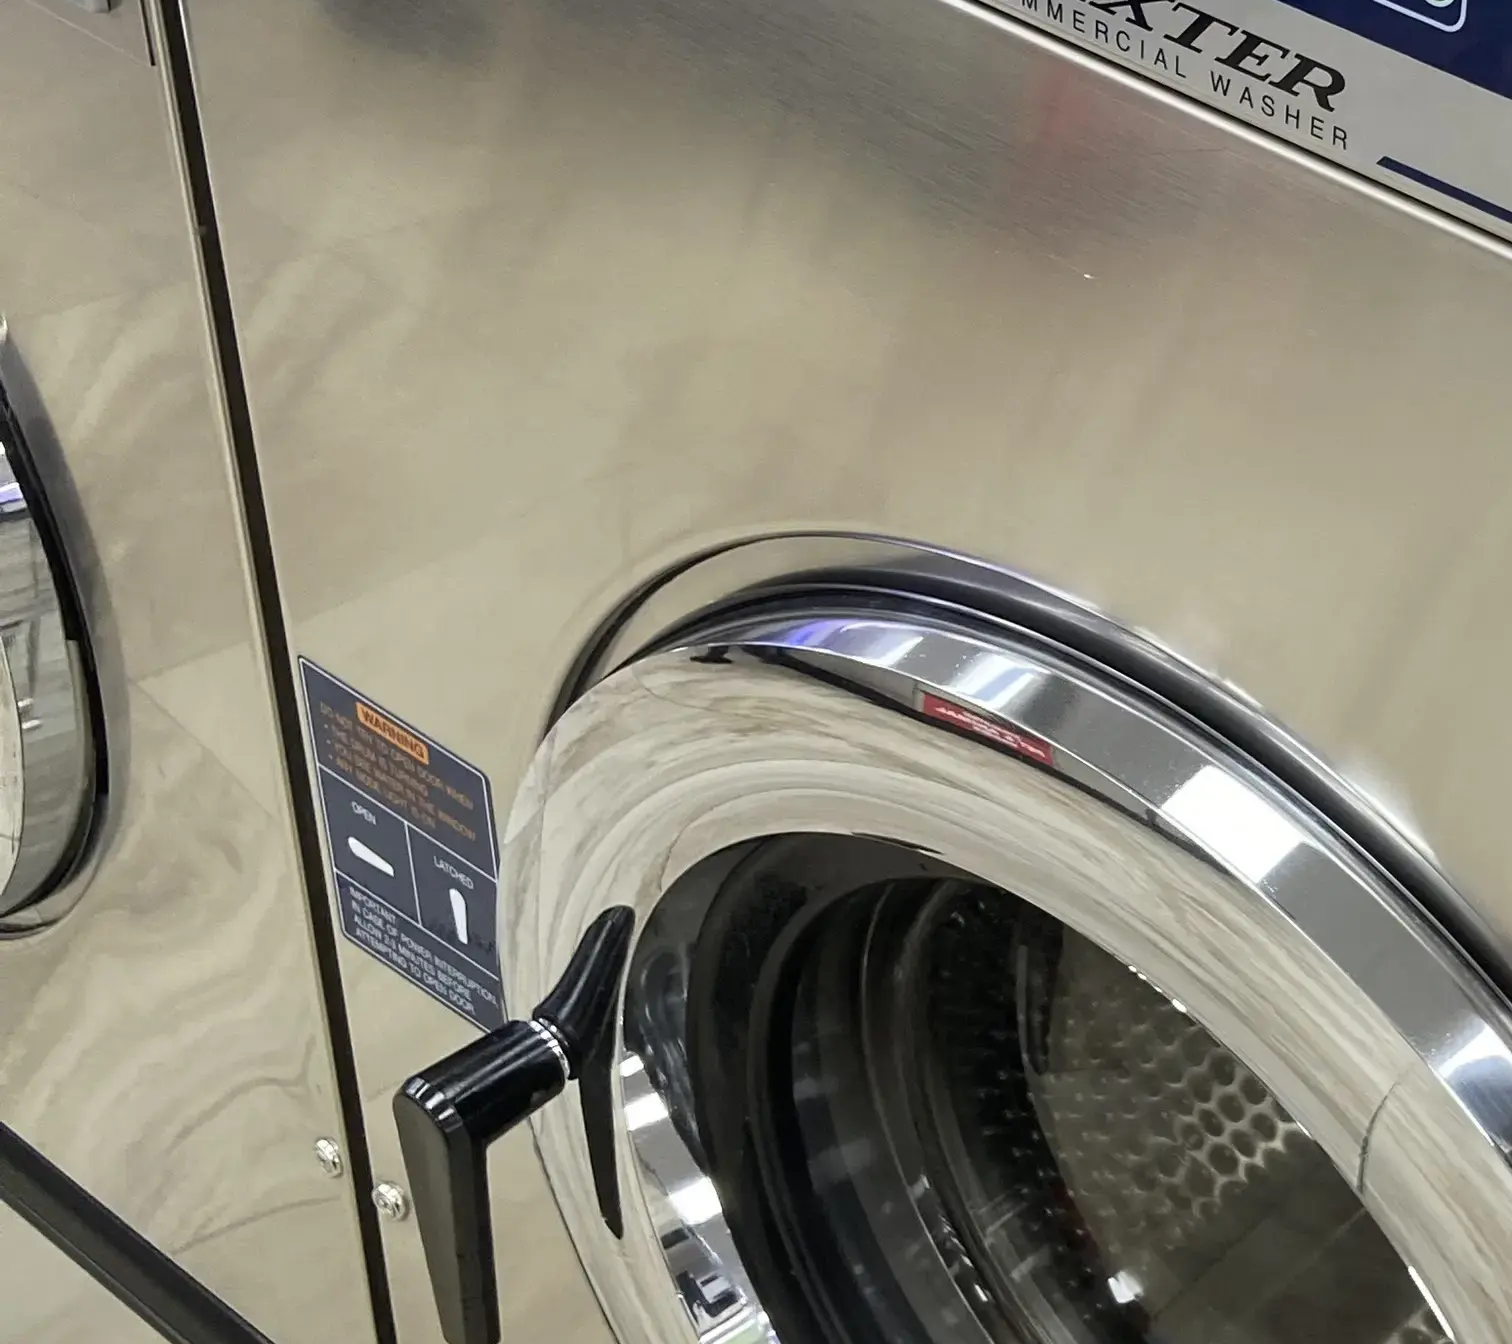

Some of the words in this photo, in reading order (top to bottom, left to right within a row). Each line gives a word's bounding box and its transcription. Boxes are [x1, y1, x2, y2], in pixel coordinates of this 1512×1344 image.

[1209, 69, 1349, 151] WASHER
[360, 706, 425, 760] WARNING
[433, 854, 475, 890] LATCHED
